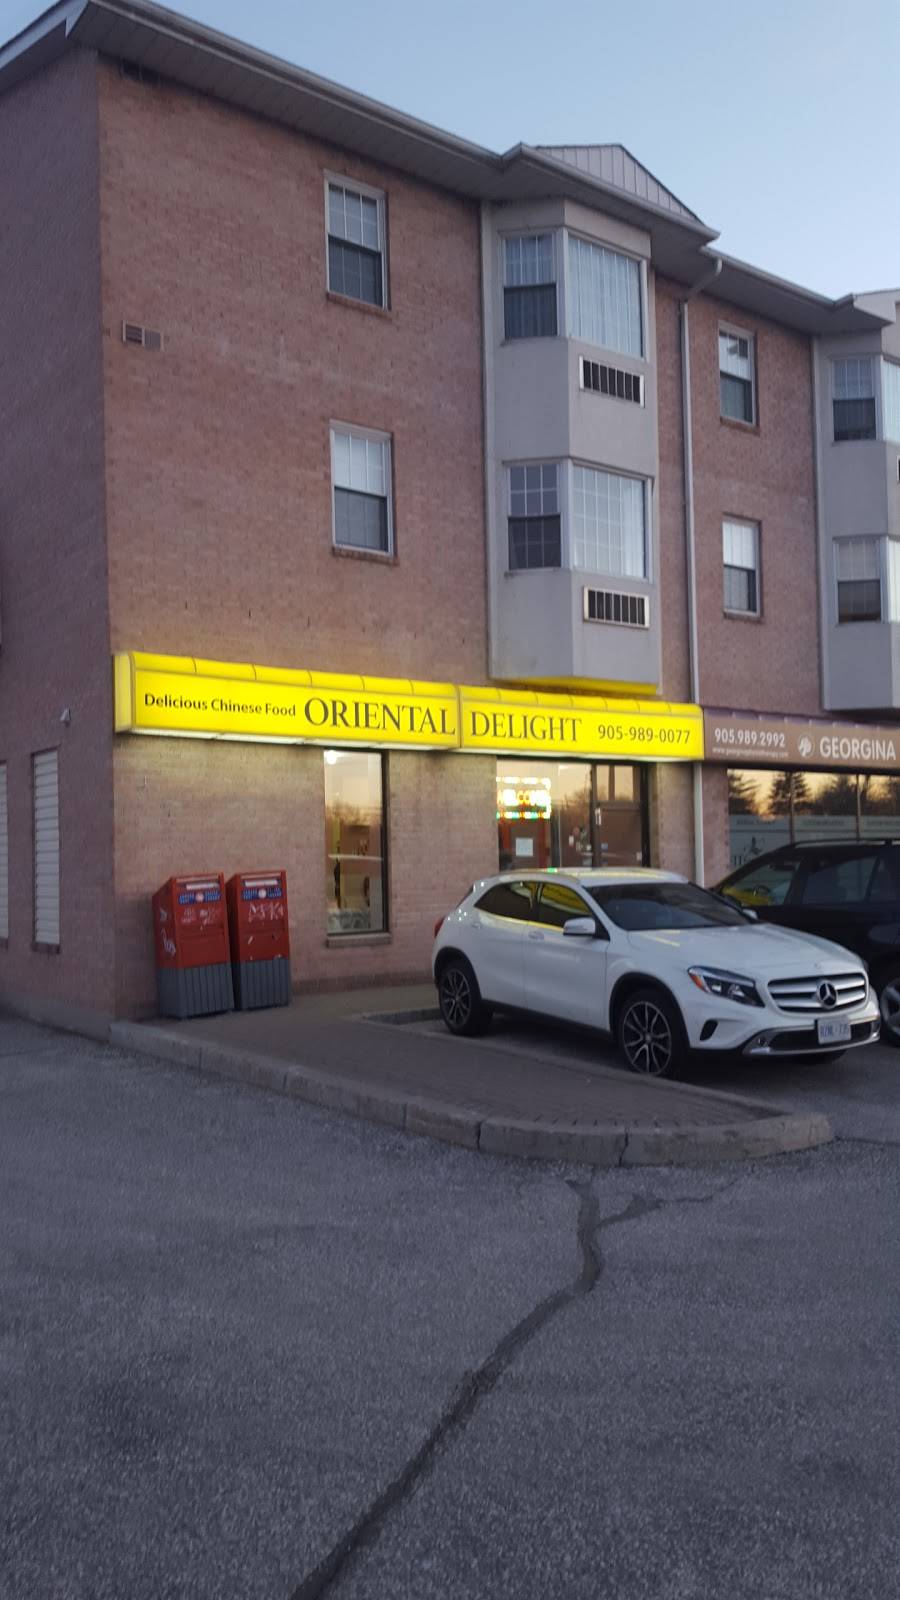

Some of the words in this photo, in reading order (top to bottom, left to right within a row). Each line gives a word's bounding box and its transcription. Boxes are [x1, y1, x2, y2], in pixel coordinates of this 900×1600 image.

[144, 693, 208, 711] Delicious
[210, 698, 262, 715] Chinese
[265, 702, 296, 717] Food
[304, 697, 456, 736] ORIENTAL
[471, 711, 582, 742] DELIGHT
[598, 725, 690, 744] 905-989-0077
[714, 728, 786, 748] 905.989.2992
[819, 736, 897, 761] GEORGINA
